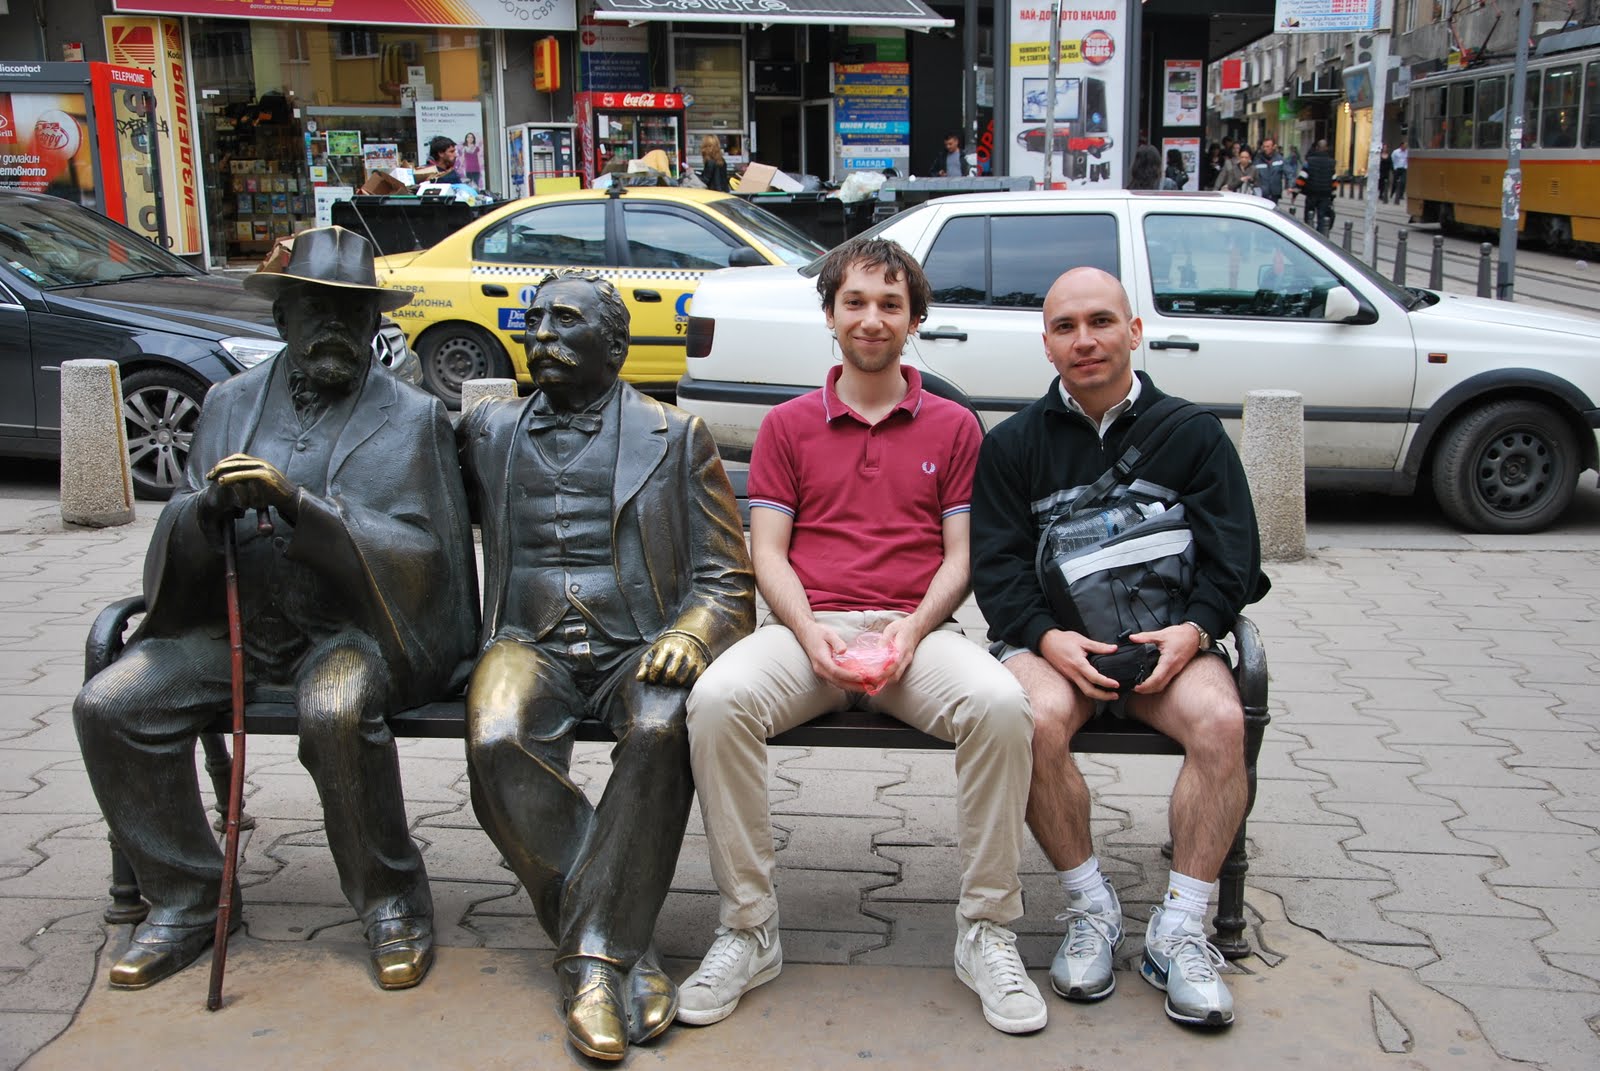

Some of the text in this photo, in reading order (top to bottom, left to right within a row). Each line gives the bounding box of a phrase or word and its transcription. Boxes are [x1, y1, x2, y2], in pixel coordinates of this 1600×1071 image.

[1020, 8, 1117, 21] НАЙ-ДООТО НАЧАЛО
[1086, 38, 1110, 47] Super
[1085, 47, 1110, 56] DEALS
[111, 69, 145, 84] TELEPHONE
[172, 62, 195, 207] ИЗДЕЛИЯ
[3, 153, 40, 165] домакин
[410, 299, 453, 308] ЦИОННА
